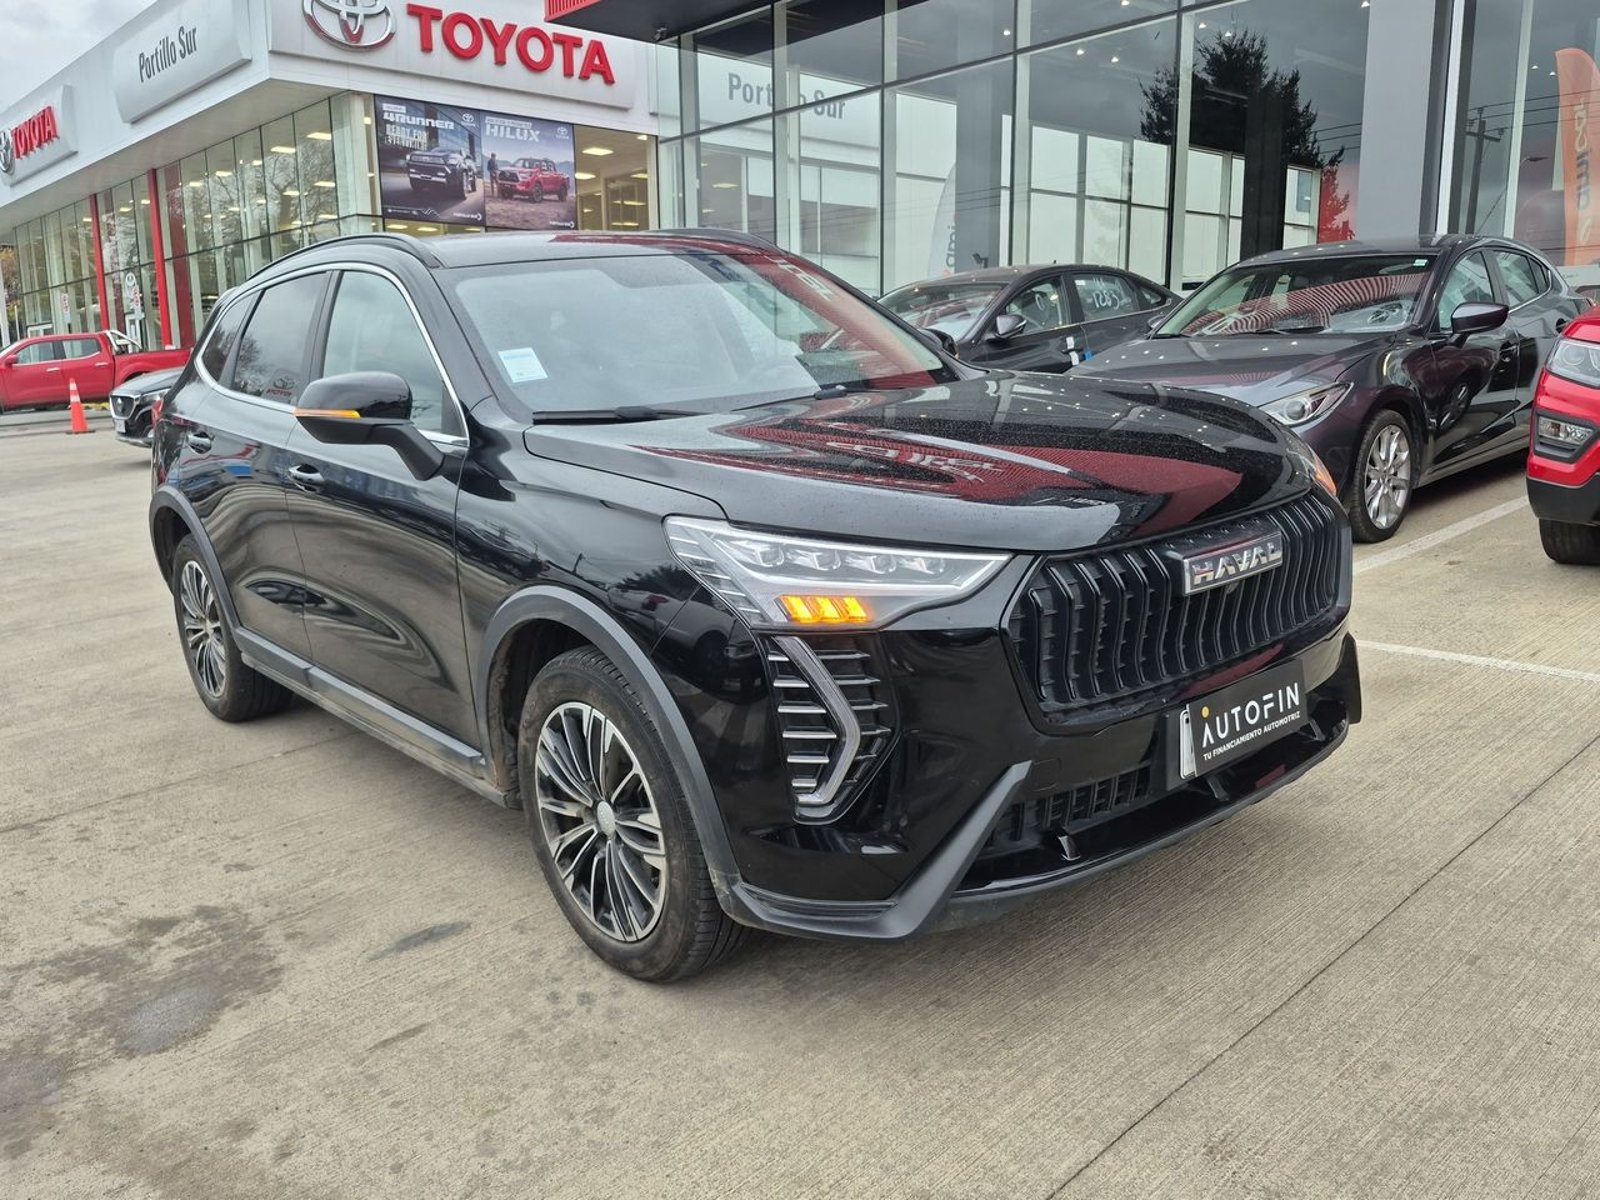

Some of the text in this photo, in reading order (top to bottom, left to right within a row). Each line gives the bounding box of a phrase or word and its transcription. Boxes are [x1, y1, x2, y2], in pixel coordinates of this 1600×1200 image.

[139, 26, 198, 83] Portillo Sur
[406, 3, 615, 85] TOYOTA
[728, 72, 846, 119] Porto Sur
[11, 106, 58, 159] TOYOTA
[486, 124, 540, 142] HILUX
[1192, 542, 1282, 585] HAVAL
[1202, 683, 1300, 748] AUTOFIN
[1203, 711, 1301, 761] TU FINANCIAMIENTO AUTOMOTRIZ
